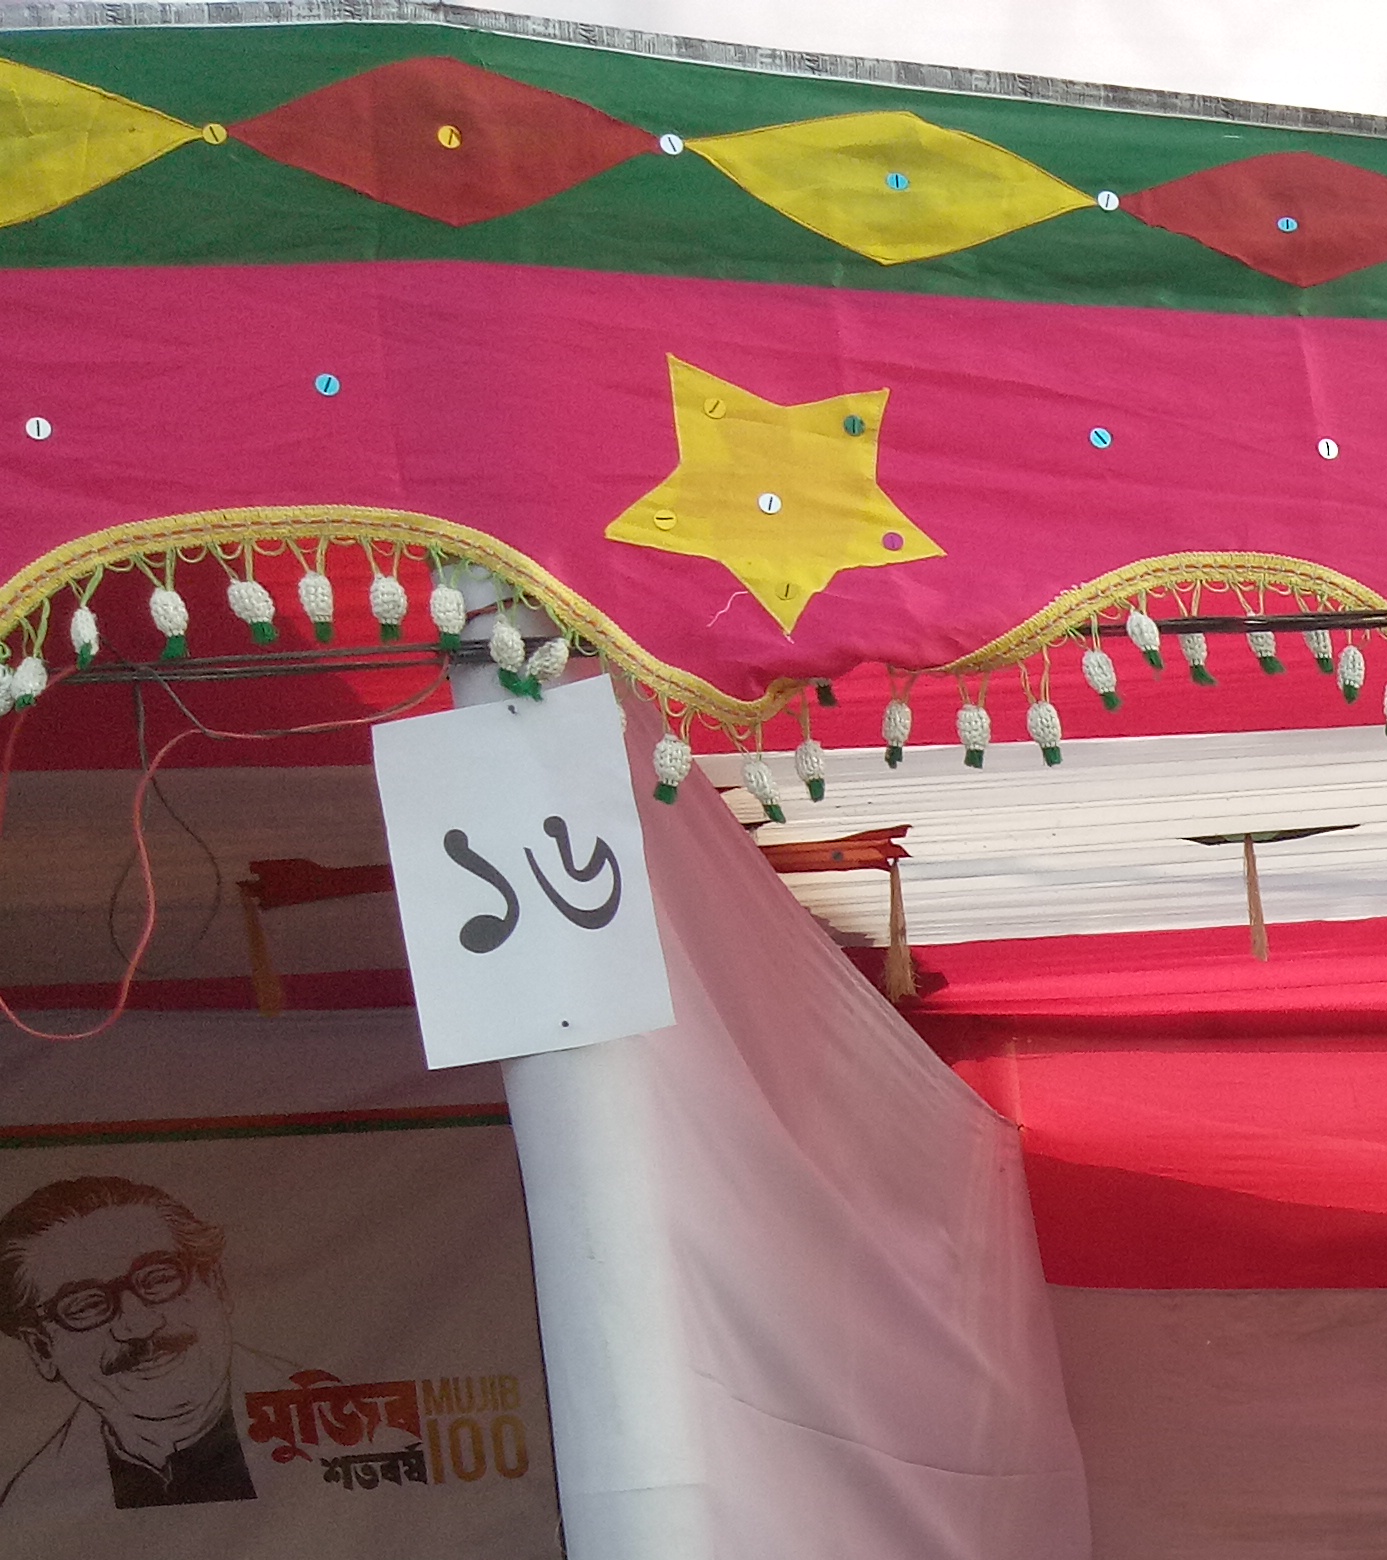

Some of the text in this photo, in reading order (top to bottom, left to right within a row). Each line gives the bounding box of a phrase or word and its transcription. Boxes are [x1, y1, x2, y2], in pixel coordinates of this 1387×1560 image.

[443, 815, 622, 954] ১৬
[245, 1369, 423, 1465] মুজিব
[421, 1375, 520, 1416] MUJIB
[319, 1442, 428, 1491] শতবর্ষ
[425, 1415, 529, 1485] 100
